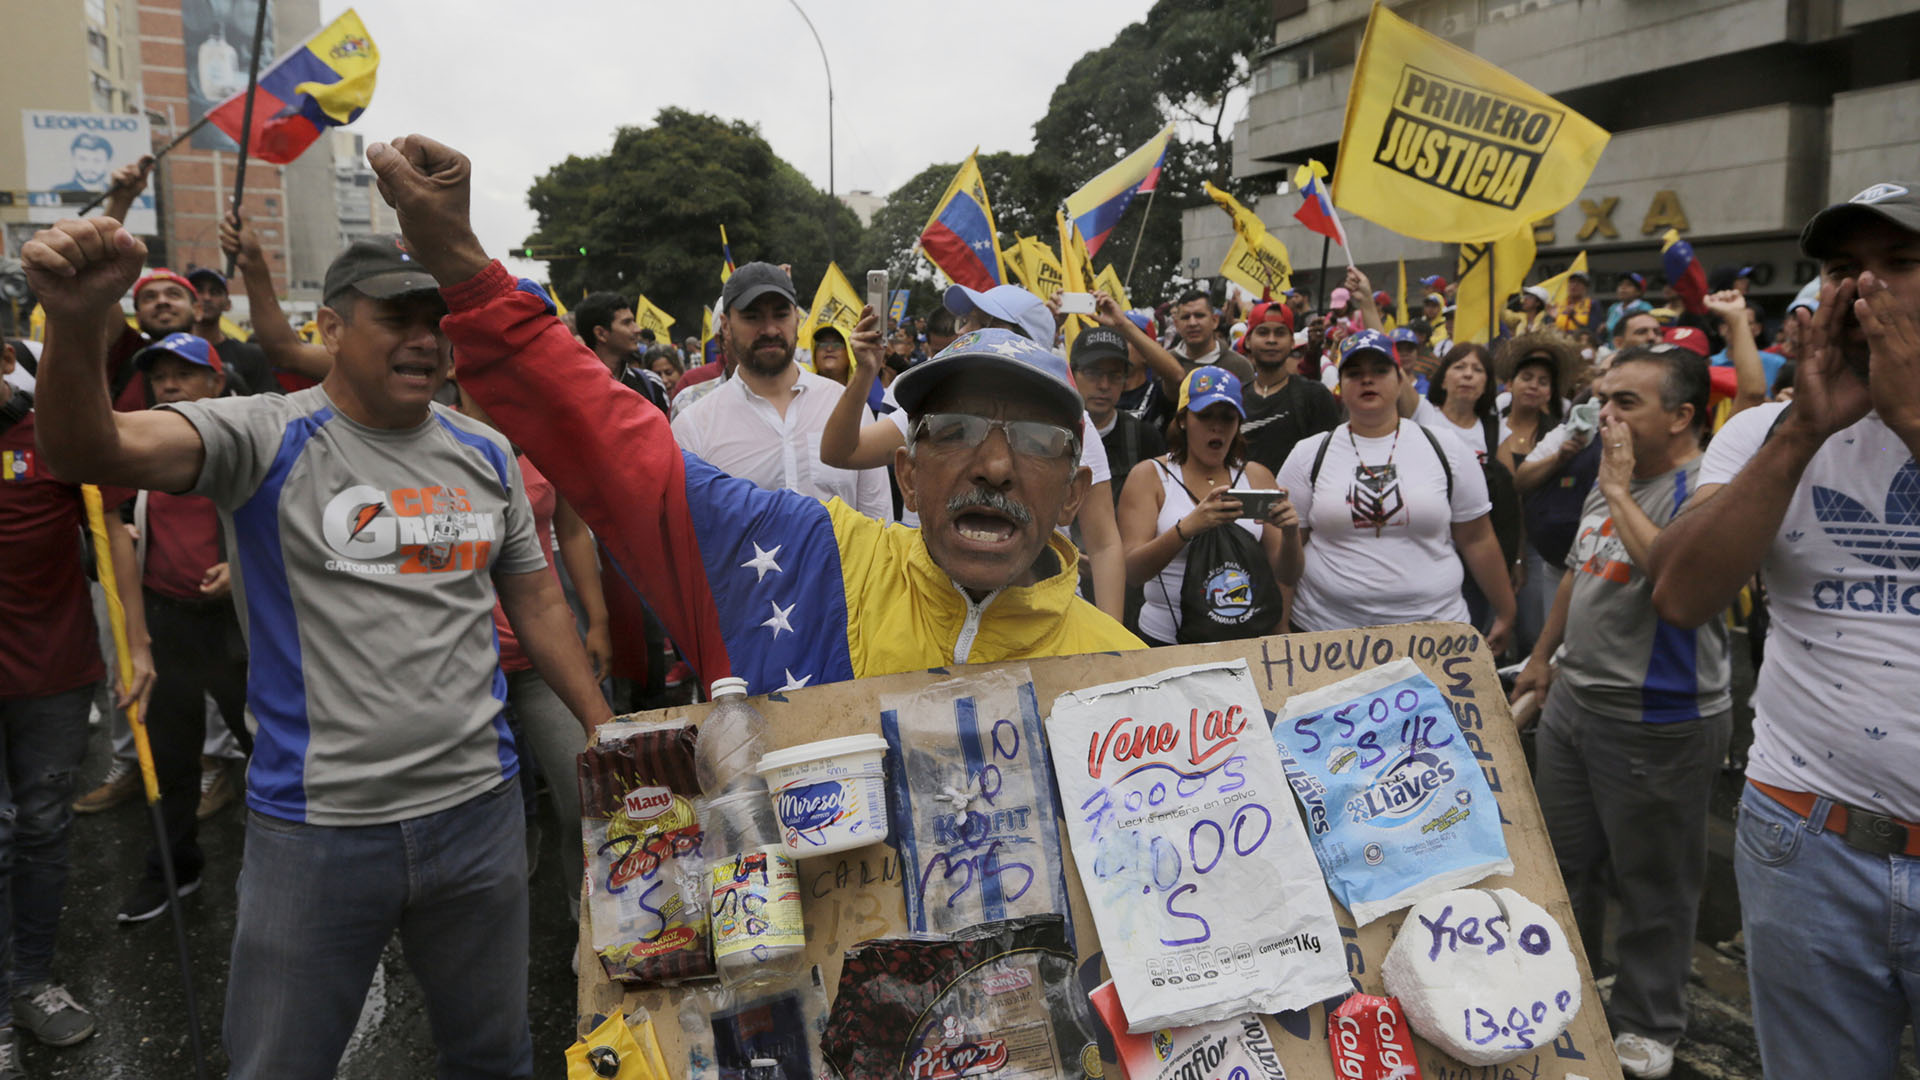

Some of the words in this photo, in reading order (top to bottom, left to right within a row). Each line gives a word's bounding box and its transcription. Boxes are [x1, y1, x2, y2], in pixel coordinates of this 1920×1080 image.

[32, 114, 138, 132] LEOPOLDO
[1401, 73, 1552, 145] PRIMERO
[1379, 116, 1532, 208] JUSTICIA
[325, 559, 396, 575] GATORADE
[1087, 717, 1181, 780] Vene
[1188, 704, 1248, 765] Lac
[626, 791, 670, 812] Mary
[778, 790, 846, 819] Mirasol
[1117, 811, 1154, 829] Leche
[1157, 803, 1200, 822] entera
[1203, 799, 1220, 810] en
[1223, 790, 1257, 806] polvo
[1281, 758, 1330, 835] Llaves
[1363, 760, 1455, 818] Llaves
[812, 852, 902, 898] CARN
[1159, 883, 1211, 947] S
[1258, 937, 1294, 955] Contenido
[1280, 946, 1297, 957] Neto
[912, 1040, 1004, 1080] Primor
[1169, 1036, 1229, 1080] caflor
[1338, 1016, 1366, 1080] Colg
